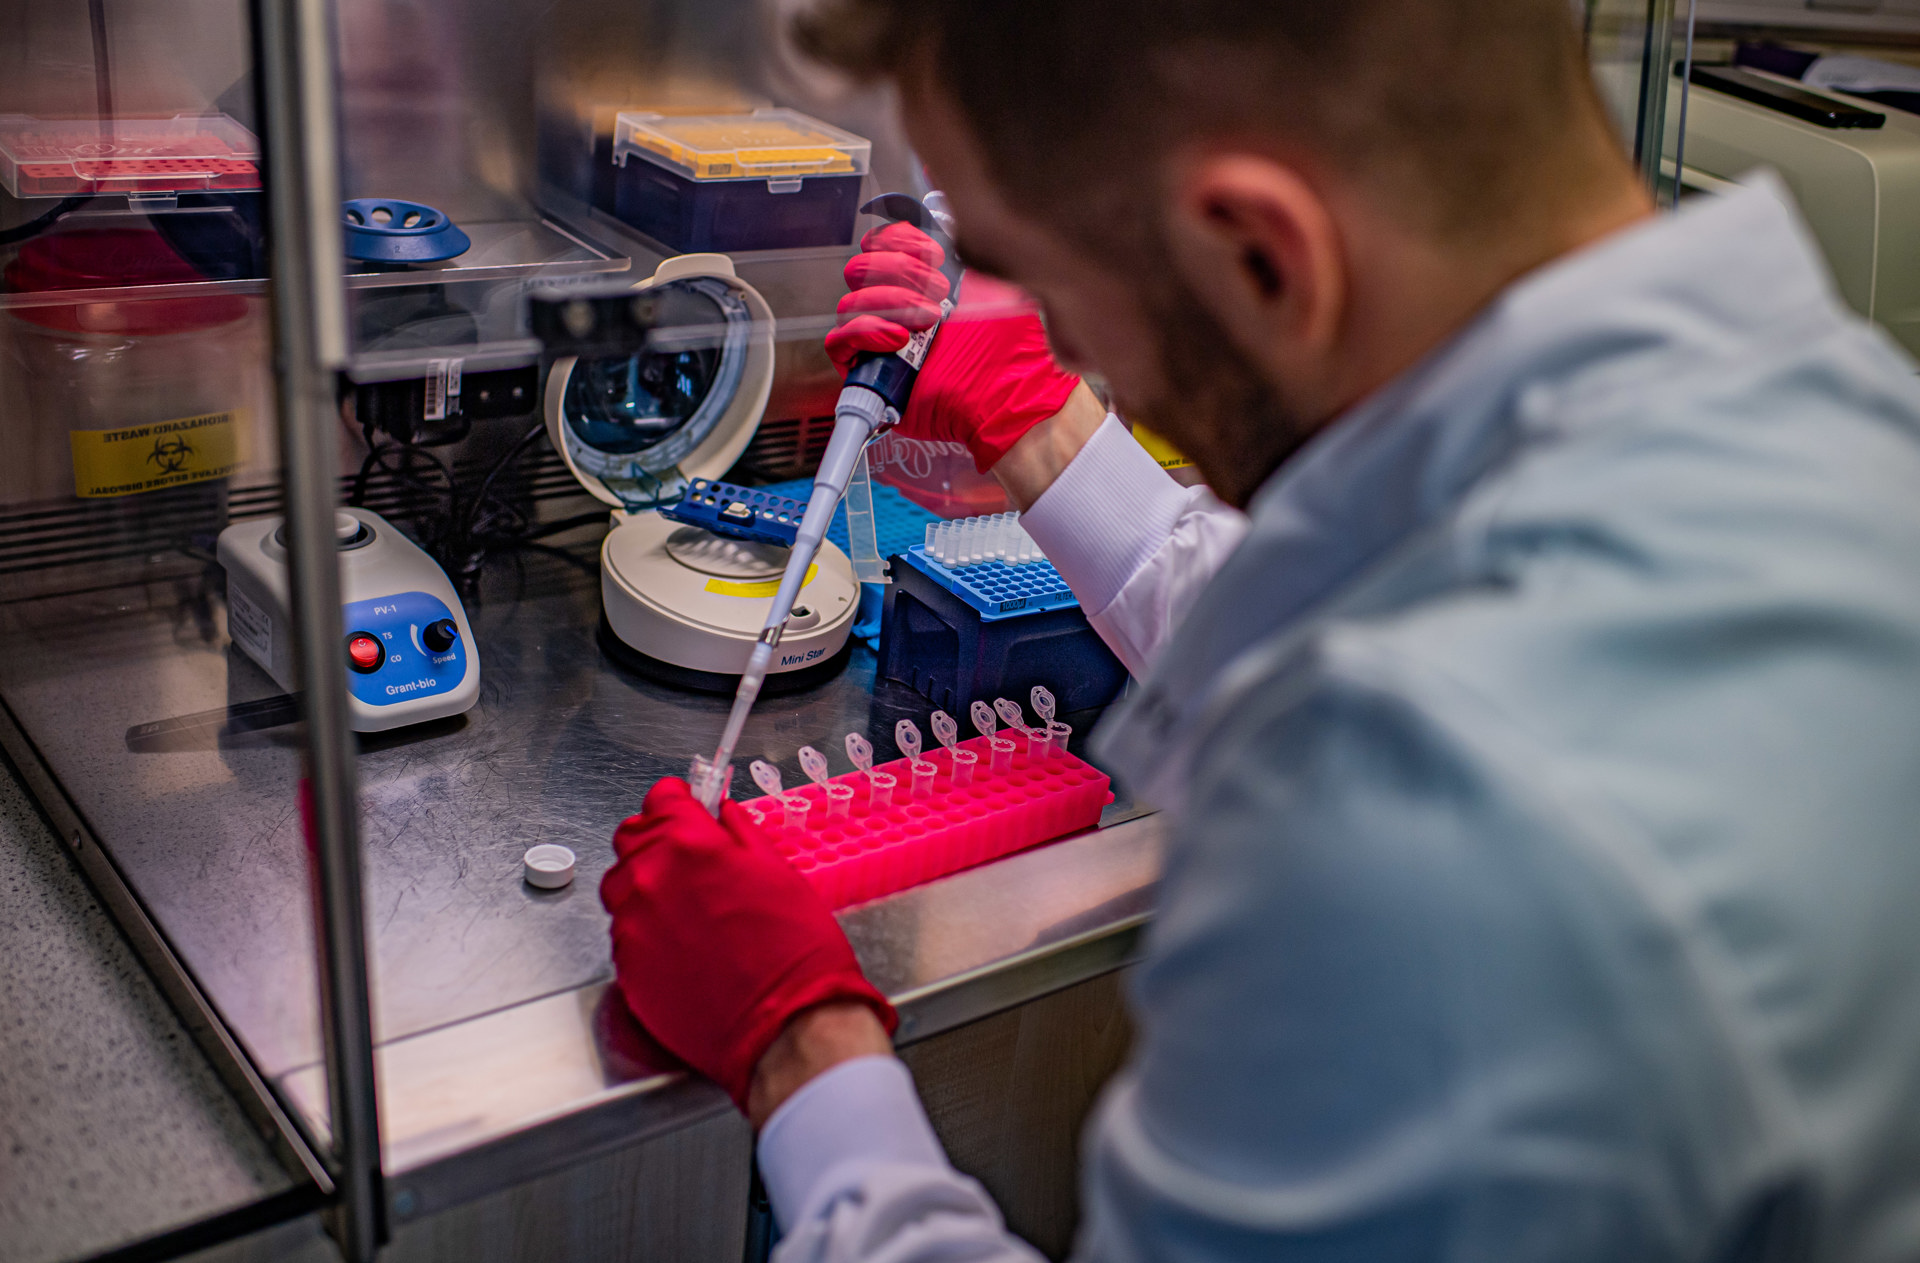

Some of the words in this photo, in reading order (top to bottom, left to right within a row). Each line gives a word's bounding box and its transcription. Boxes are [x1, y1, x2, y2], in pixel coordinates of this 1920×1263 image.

[374, 604, 397, 616] PV-1
[382, 632, 393, 640] TS
[391, 654, 402, 663] CO
[433, 653, 456, 665] Speed
[781, 653, 804, 666] Mini
[805, 647, 826, 661] Star
[385, 678, 437, 696] Grant-bio
